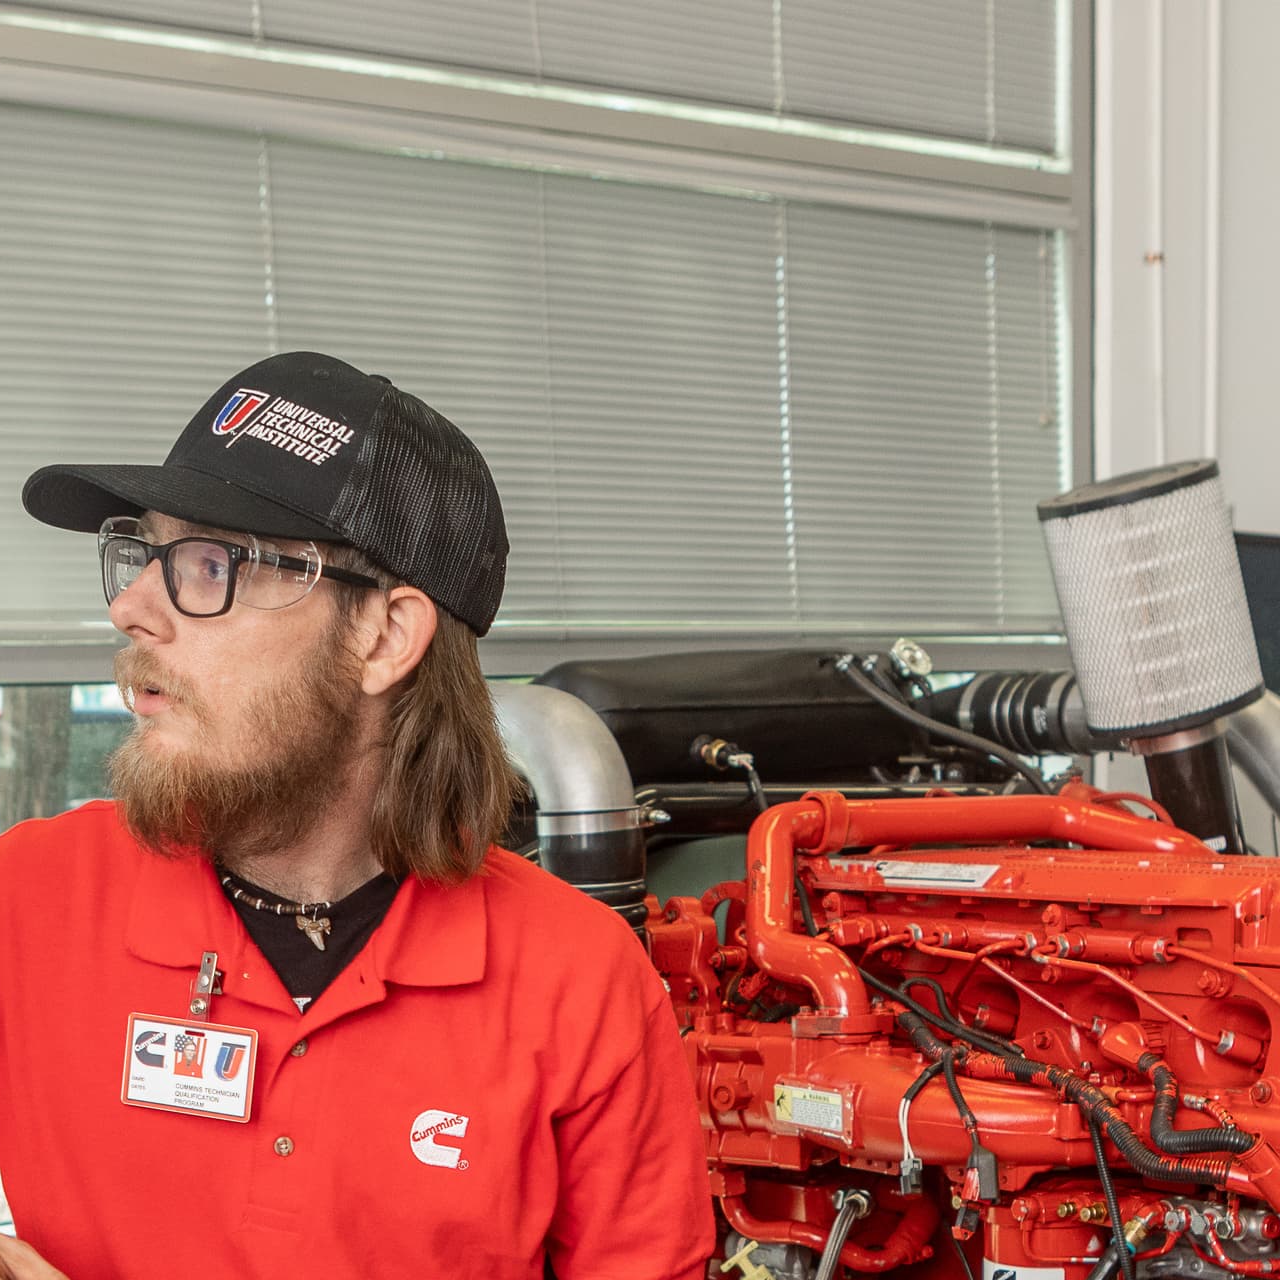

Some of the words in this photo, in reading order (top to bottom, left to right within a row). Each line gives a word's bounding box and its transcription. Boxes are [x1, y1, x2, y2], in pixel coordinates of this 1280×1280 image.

[260, 411, 342, 457] TECHNICAL
[273, 399, 355, 444] UNIVERSAL
[246, 423, 331, 466] INSTITUTE
[174, 1091, 220, 1104] QUALIFICATION
[175, 1082, 203, 1094] CUMMINS
[174, 1098, 206, 1108] PROGRAM
[412, 1116, 463, 1142] Cummins
